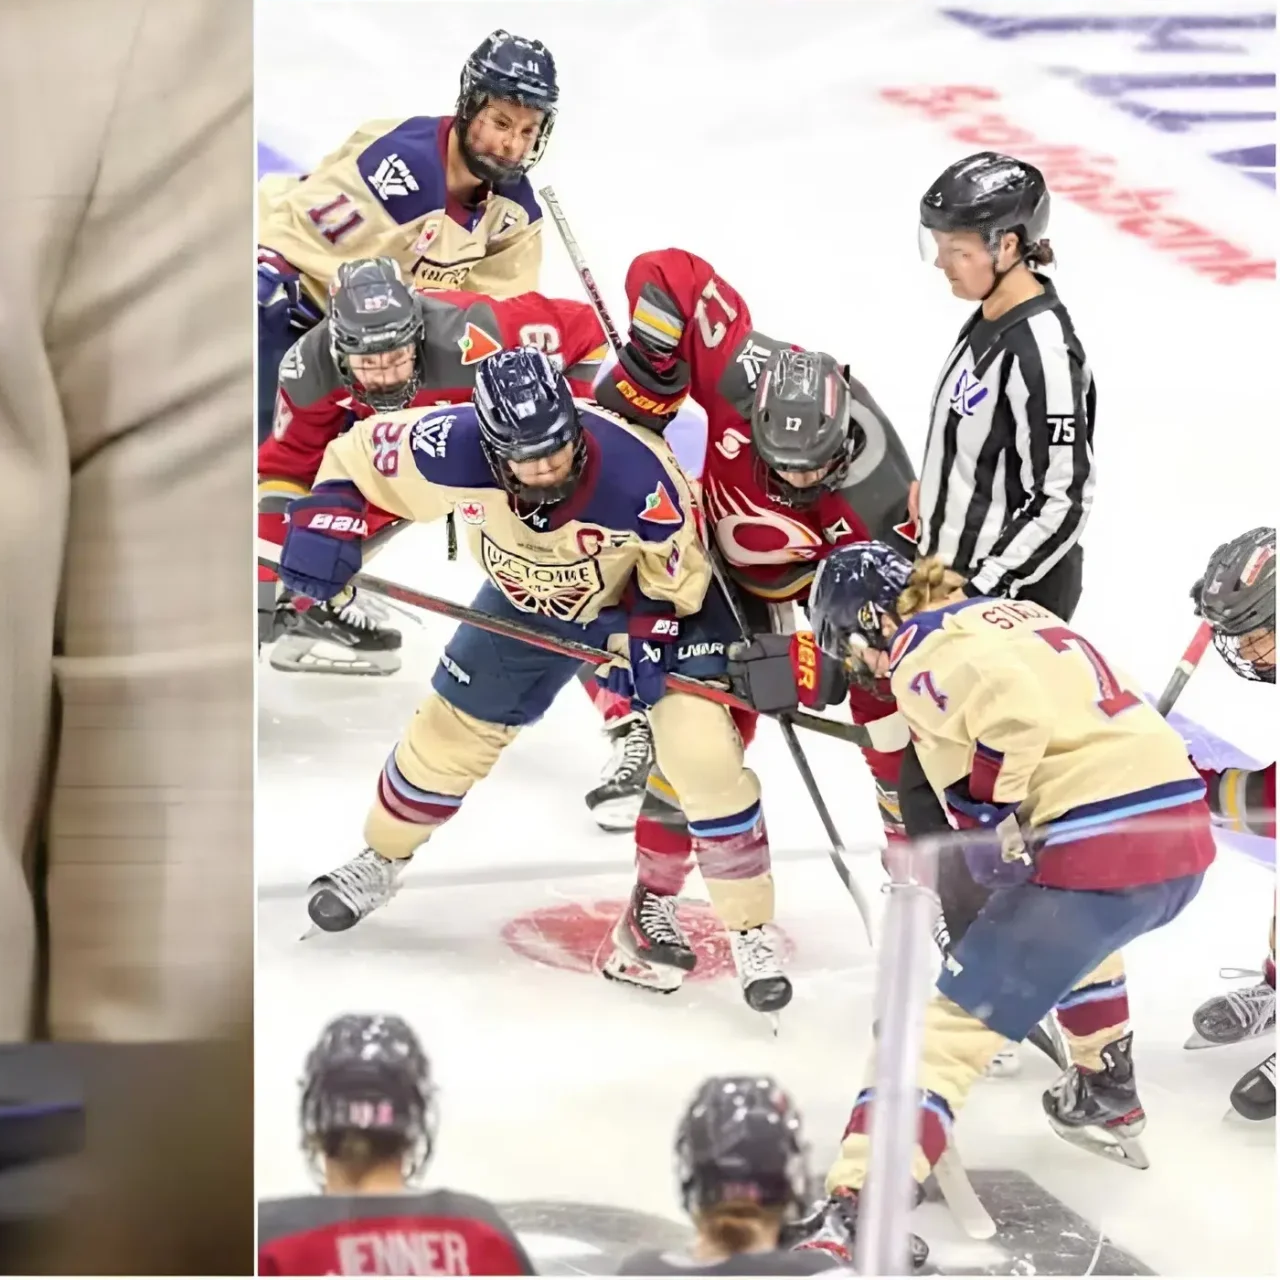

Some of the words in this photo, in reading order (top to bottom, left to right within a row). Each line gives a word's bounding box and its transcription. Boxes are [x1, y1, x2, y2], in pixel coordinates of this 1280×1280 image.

[307, 193, 365, 245] 11
[1048, 417, 1076, 445] 75
[910, 669, 949, 713] 7
[1034, 626, 1143, 719] 7
